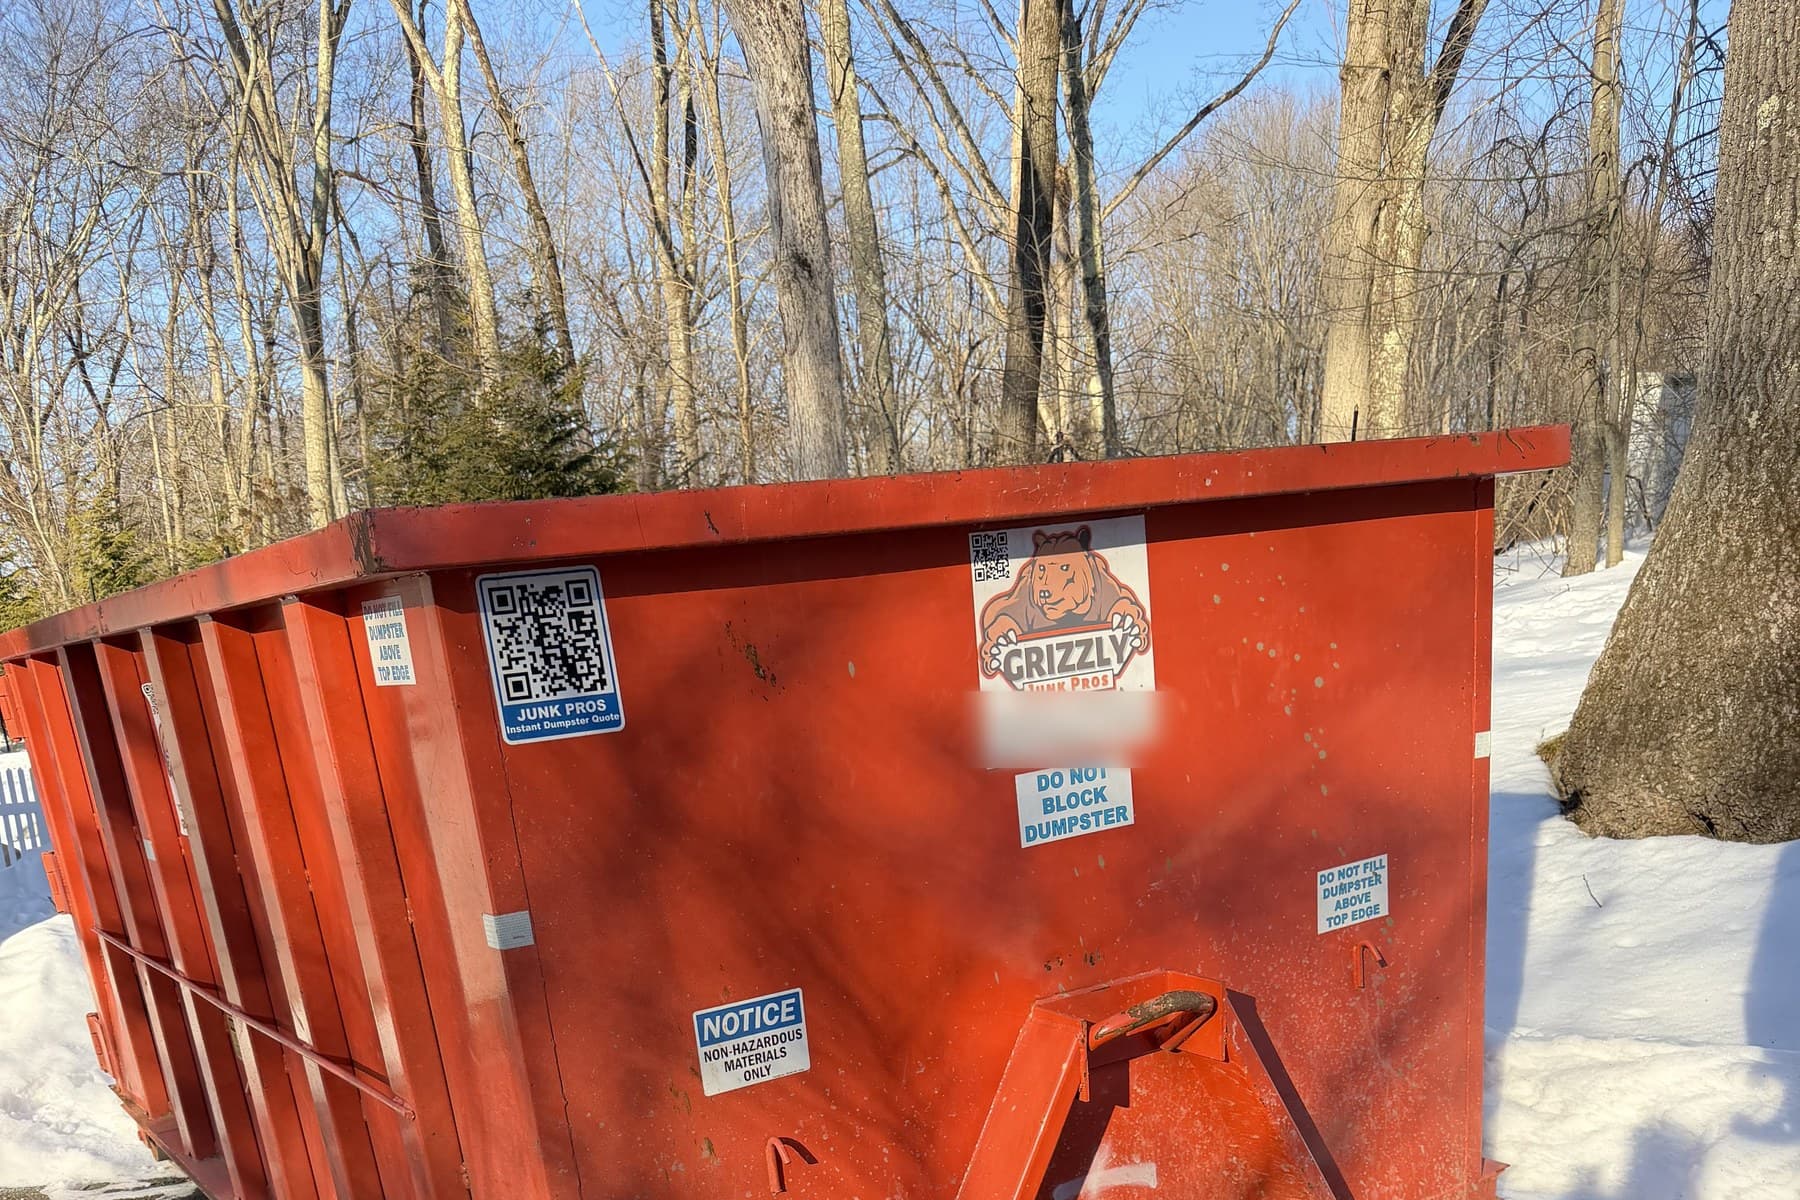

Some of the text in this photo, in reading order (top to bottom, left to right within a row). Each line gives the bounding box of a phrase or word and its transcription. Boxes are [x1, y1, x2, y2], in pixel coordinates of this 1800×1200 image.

[369, 623, 404, 640] DUMPSTER
[379, 645, 401, 661] ABOVE
[1003, 633, 1129, 680] GRIZZLY
[378, 665, 410, 681] TOP EDGE
[517, 700, 606, 721] JUNK PROS
[506, 713, 620, 734] Instant Dumpster Quote
[1037, 771, 1064, 792] DO
[1042, 785, 1108, 815] BLOCK
[1025, 805, 1129, 843] DUMPSTER
[1320, 859, 1385, 885] DO NOT FILL
[1322, 873, 1382, 900] DUMPSTER
[1335, 892, 1371, 911] ABOVE
[1326, 904, 1380, 927] TOP EDGE
[703, 998, 796, 1041] NOTICE
[703, 1028, 803, 1064] NON-HAZARDOUS
[724, 1046, 787, 1073] MATERIALS
[743, 1064, 772, 1082] ONLY
